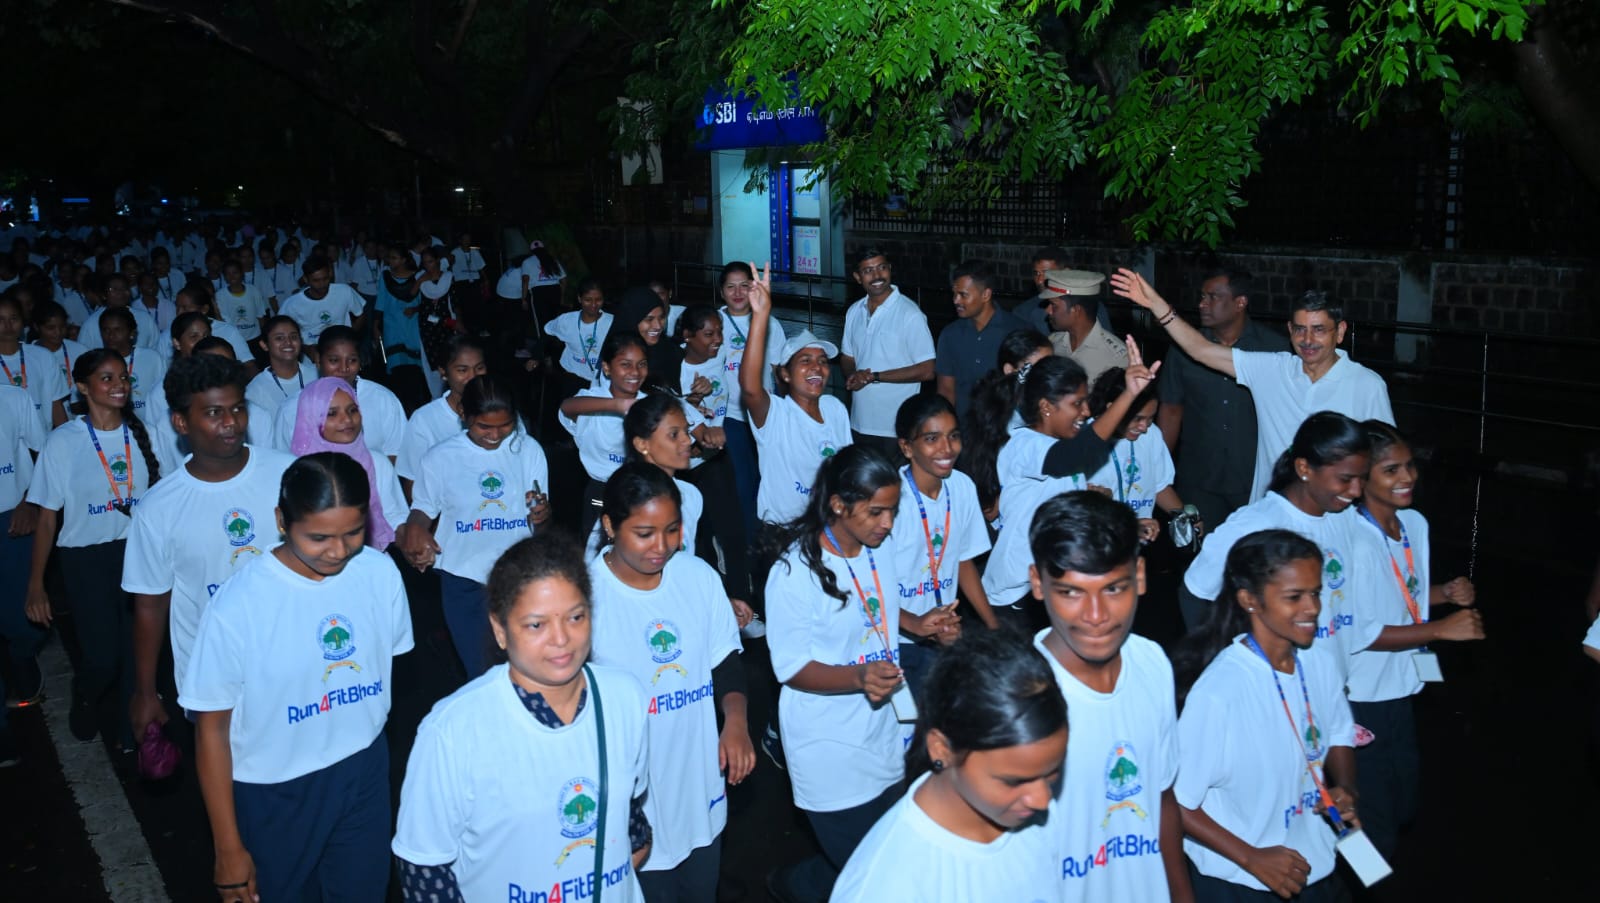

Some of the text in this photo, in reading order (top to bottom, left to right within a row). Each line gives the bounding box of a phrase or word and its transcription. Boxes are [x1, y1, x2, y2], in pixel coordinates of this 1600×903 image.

[715, 101, 737, 124] SBI
[456, 518, 527, 533] Run4FitBharat
[648, 680, 714, 714] 4FitBharat
